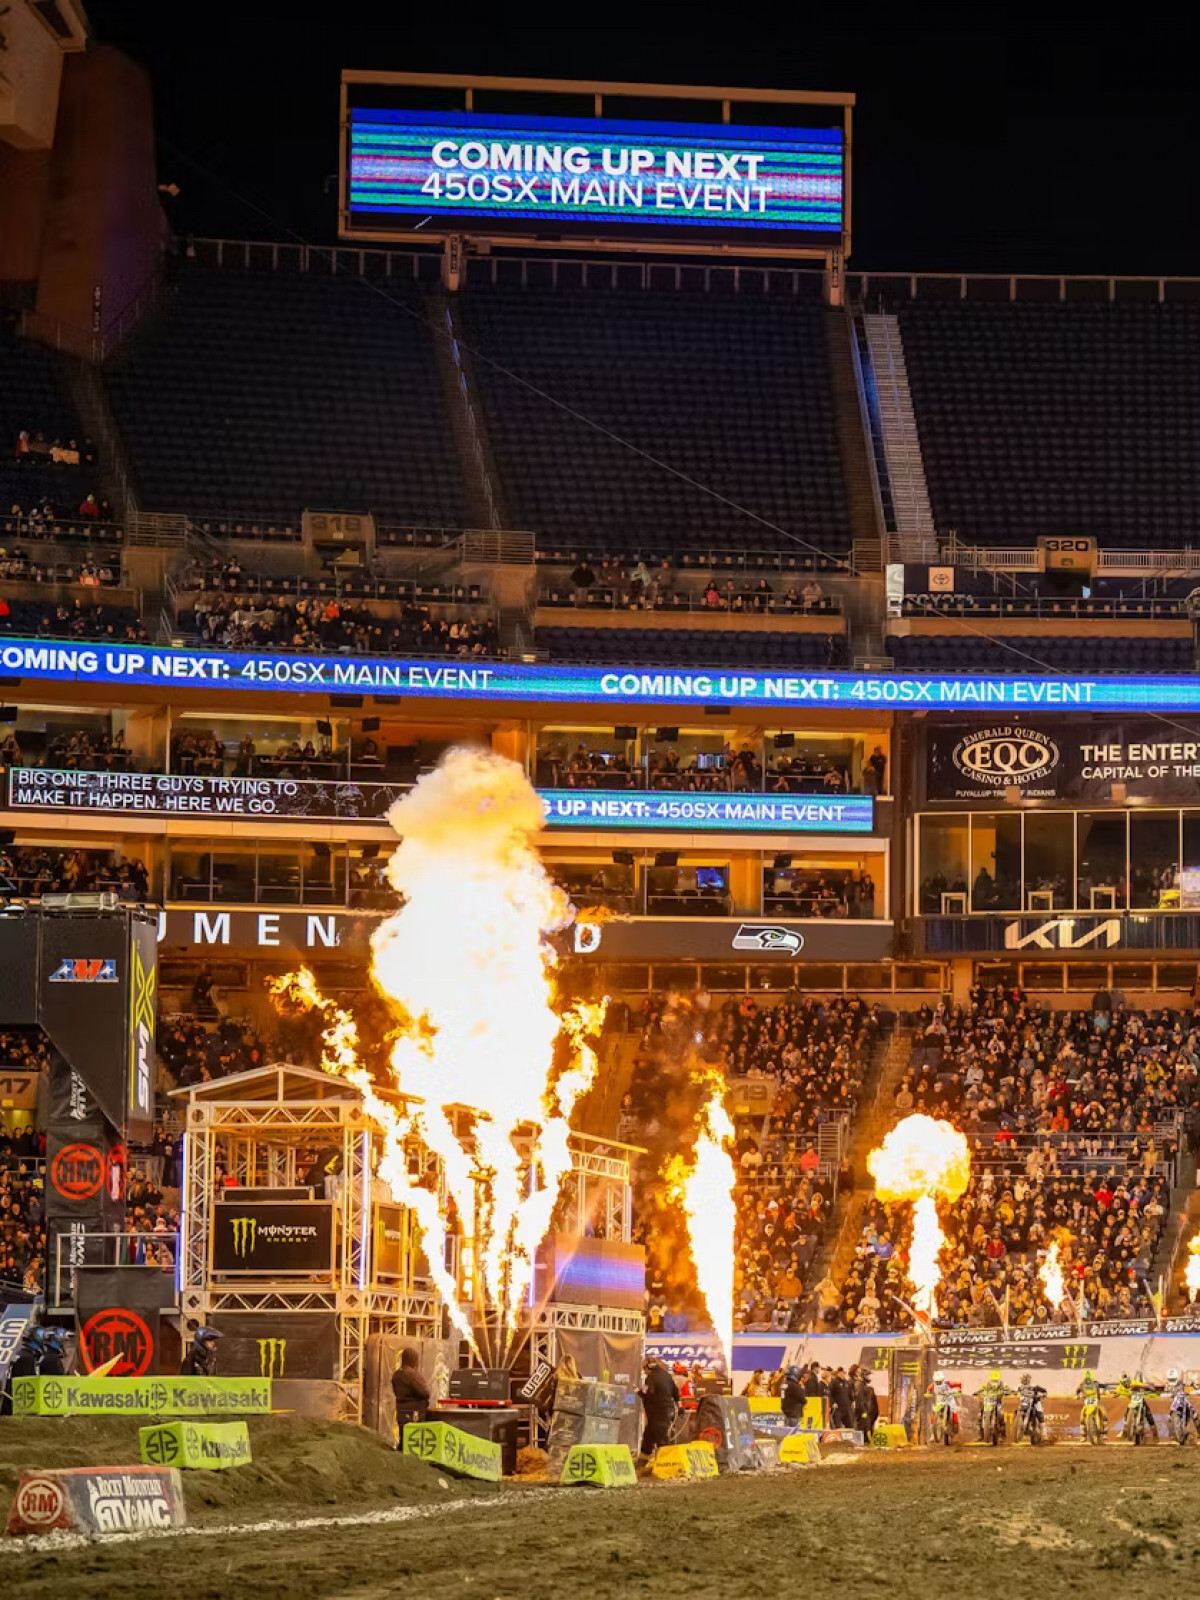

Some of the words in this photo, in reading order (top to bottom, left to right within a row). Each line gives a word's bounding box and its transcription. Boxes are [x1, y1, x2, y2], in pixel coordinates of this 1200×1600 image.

[431, 140, 591, 174] COMING
[601, 148, 653, 176] UP
[665, 151, 765, 181] NEXT
[421, 172, 539, 204] 450SX
[551, 177, 643, 207] MAIN
[656, 181, 773, 214] EVENT
[1046, 539, 1089, 552] 320
[0, 646, 98, 673] OMING
[106, 652, 145, 675] UP
[152, 655, 230, 680] NEXT:
[241, 659, 326, 684] 450SX
[333, 662, 403, 687] MAIN
[408, 665, 493, 691] EVENT
[600, 673, 713, 696] COMING
[720, 677, 758, 698] UP
[764, 678, 839, 700] NEXT:
[850, 680, 931, 702] 450SX
[939, 681, 1005, 702] MAIN
[1013, 682, 1096, 703] EVENT
[963, 727, 1012, 747] EMERALD
[1014, 727, 1050, 745] QUEEN
[973, 742, 1043, 775] EQC
[1080, 744, 1122, 763] THE
[18, 770, 48, 785] BIG
[51, 772, 94, 788] ONE.
[97, 775, 153, 791] THREE
[156, 777, 204, 792] GUYS
[208, 778, 271, 795] TRYING
[274, 781, 298, 796] TO
[961, 766, 1002, 786] CASINO
[1003, 776, 1012, 786] &
[1013, 766, 1052, 785] HOTEL
[1081, 765, 1144, 780] CAPITAL
[1148, 764, 1169, 778] OF
[18, 789, 65, 805] MAKE
[69, 791, 85, 805] IT
[89, 792, 161, 810] HAPPEN.
[165, 796, 212, 811] HERE
[215, 797, 244, 813] WE
[248, 798, 280, 814] GO.
[1027, 789, 1056, 798] INDIANS
[557, 799, 586, 817] UP
[590, 800, 651, 818] NEXT:
[656, 801, 720, 820] 450SX
[724, 802, 776, 821] MAIN
[780, 803, 845, 822] EVENT
[157, 911, 337, 948] MEN
[50, 958, 118, 980] AMA
[0, 1078, 31, 1095] 17
[737, 1084, 768, 1101] 19
[257, 1224, 318, 1237] MONSTER
[94, 1330, 139, 1364] RM
[938, 1345, 1049, 1355] ONSTER
[937, 1357, 1048, 1366] ONSTER
[521, 1361, 551, 1398] WPS
[66, 1387, 150, 1409] Kawasaki
[172, 1387, 269, 1409] Kawasaki
[96, 1476, 123, 1497] ROCKY
[122, 1475, 163, 1496] MOUNTAIN
